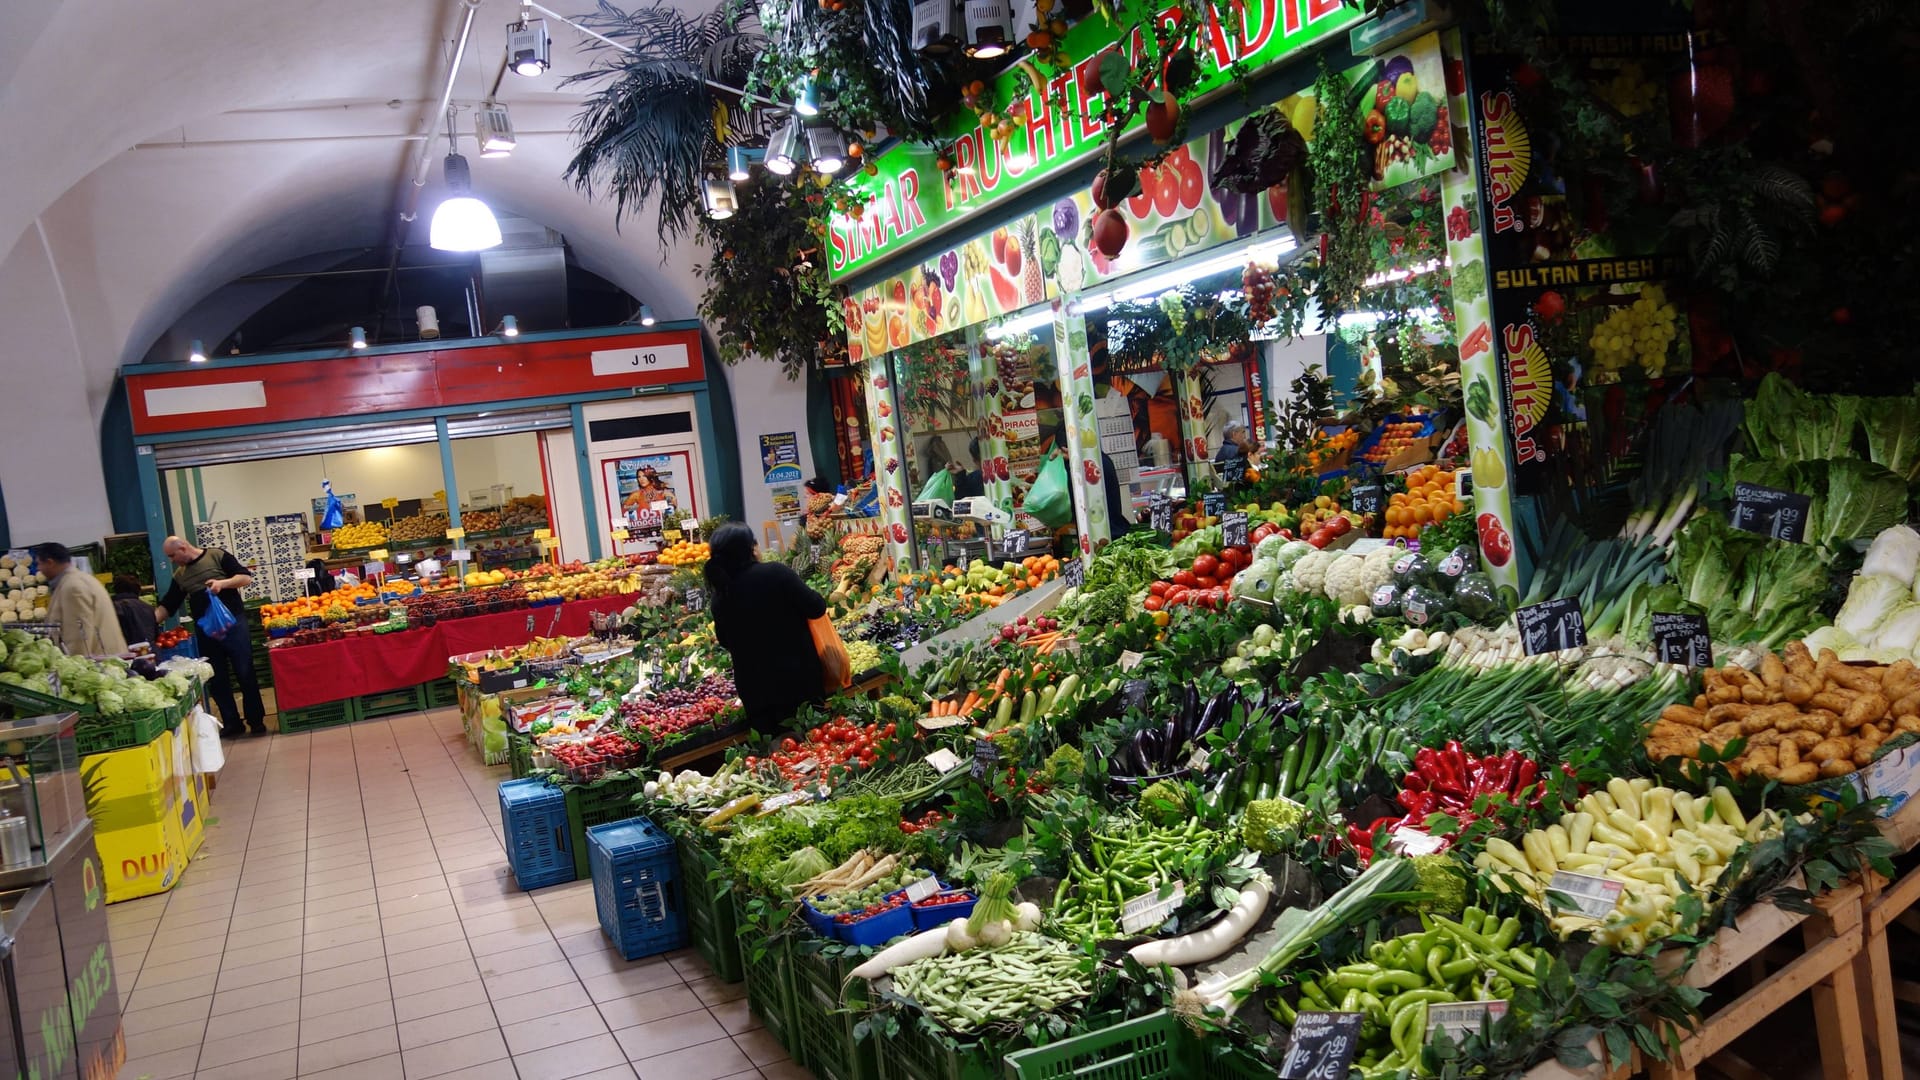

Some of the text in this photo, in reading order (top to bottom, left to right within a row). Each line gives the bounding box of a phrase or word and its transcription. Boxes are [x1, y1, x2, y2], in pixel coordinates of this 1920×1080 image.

[1480, 89, 1516, 235] Sultan
[829, 167, 927, 272] SIMAR
[1494, 265, 1581, 290] SULTAN
[1587, 257, 1655, 282] FRESH
[632, 353, 656, 366] J 10
[1502, 322, 1539, 466] Sultan
